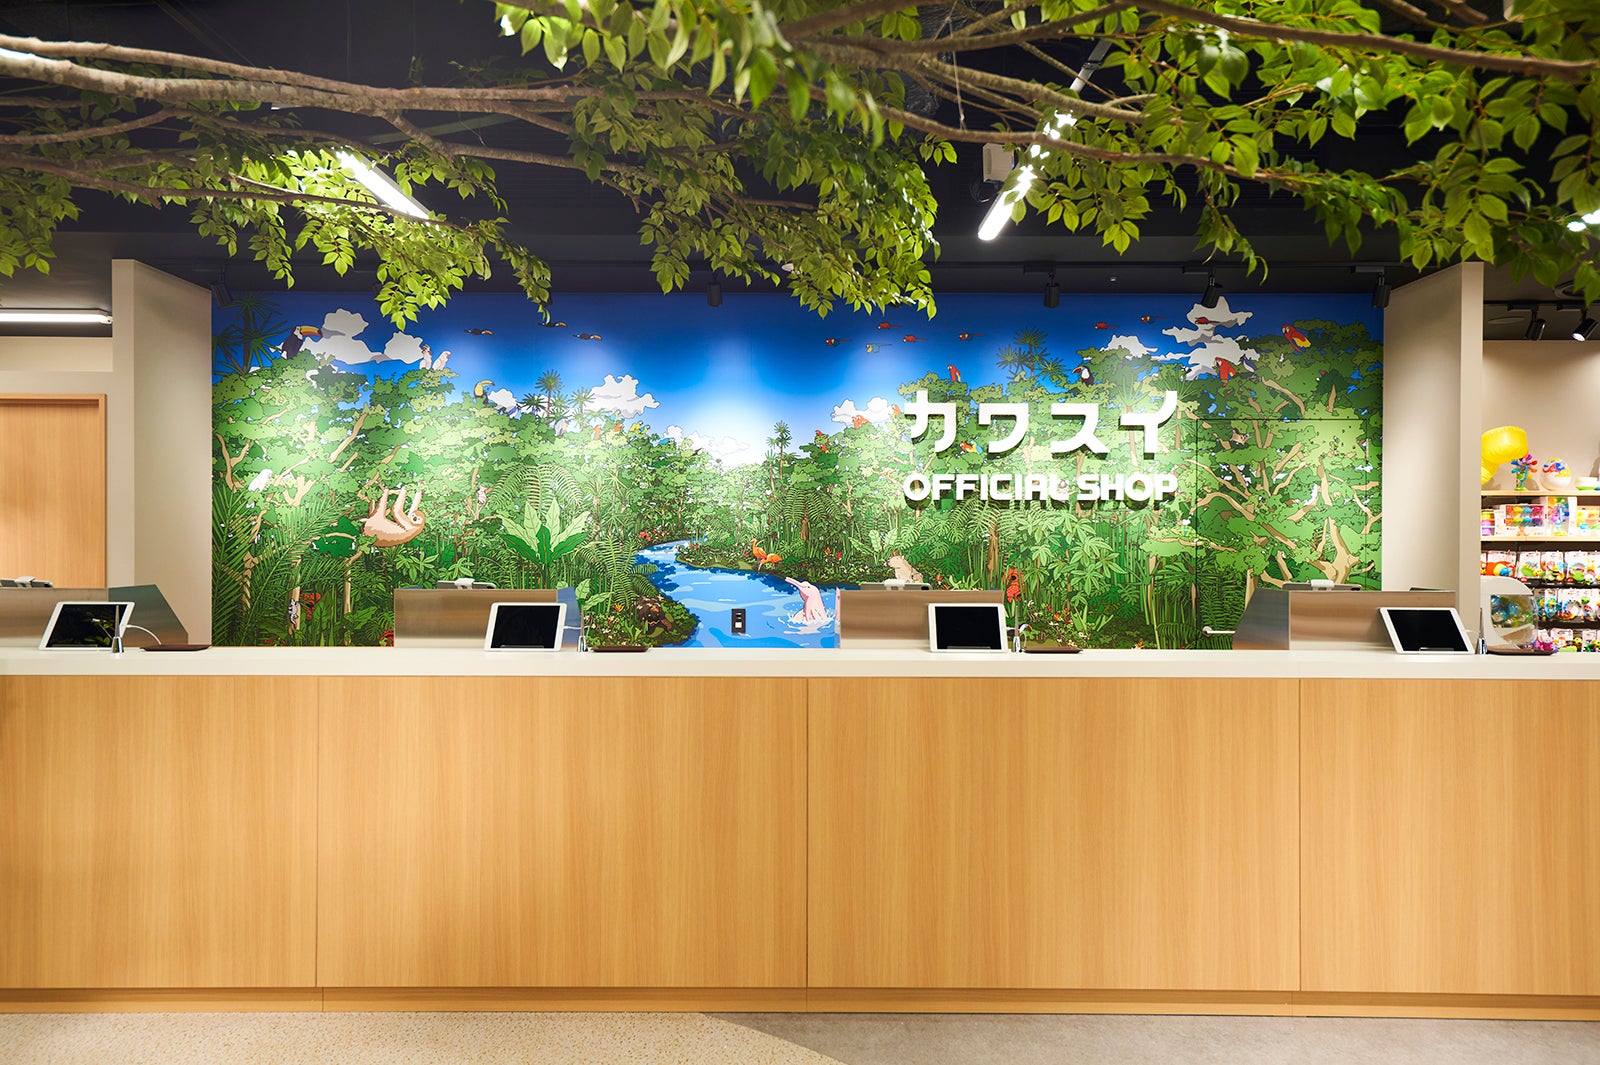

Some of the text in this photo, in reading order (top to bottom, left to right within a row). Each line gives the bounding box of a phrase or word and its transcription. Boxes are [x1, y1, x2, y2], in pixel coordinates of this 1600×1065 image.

[904, 390, 1178, 453] カワスイ
[903, 472, 1179, 501] OFFICIAL SHOP
